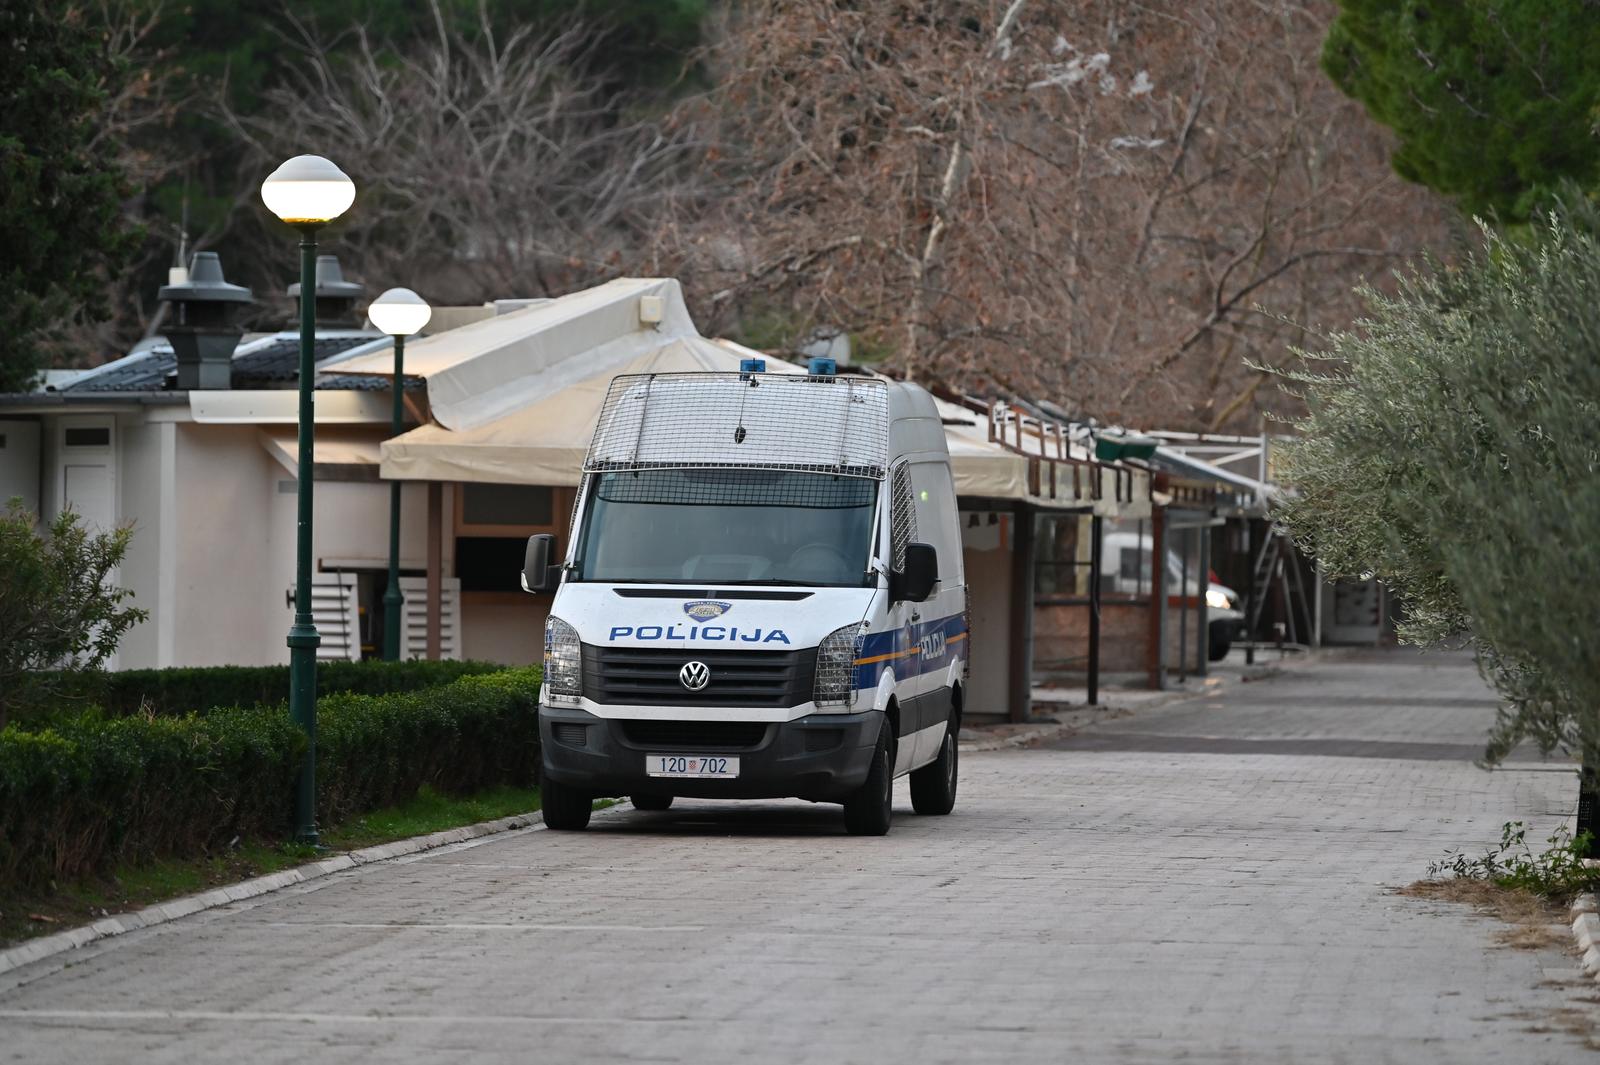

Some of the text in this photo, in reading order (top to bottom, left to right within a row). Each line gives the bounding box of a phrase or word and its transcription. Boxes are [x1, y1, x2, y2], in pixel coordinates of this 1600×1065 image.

[609, 626, 791, 645] POLICIJA
[680, 661, 710, 690] VW
[661, 757, 727, 773] 120 702
